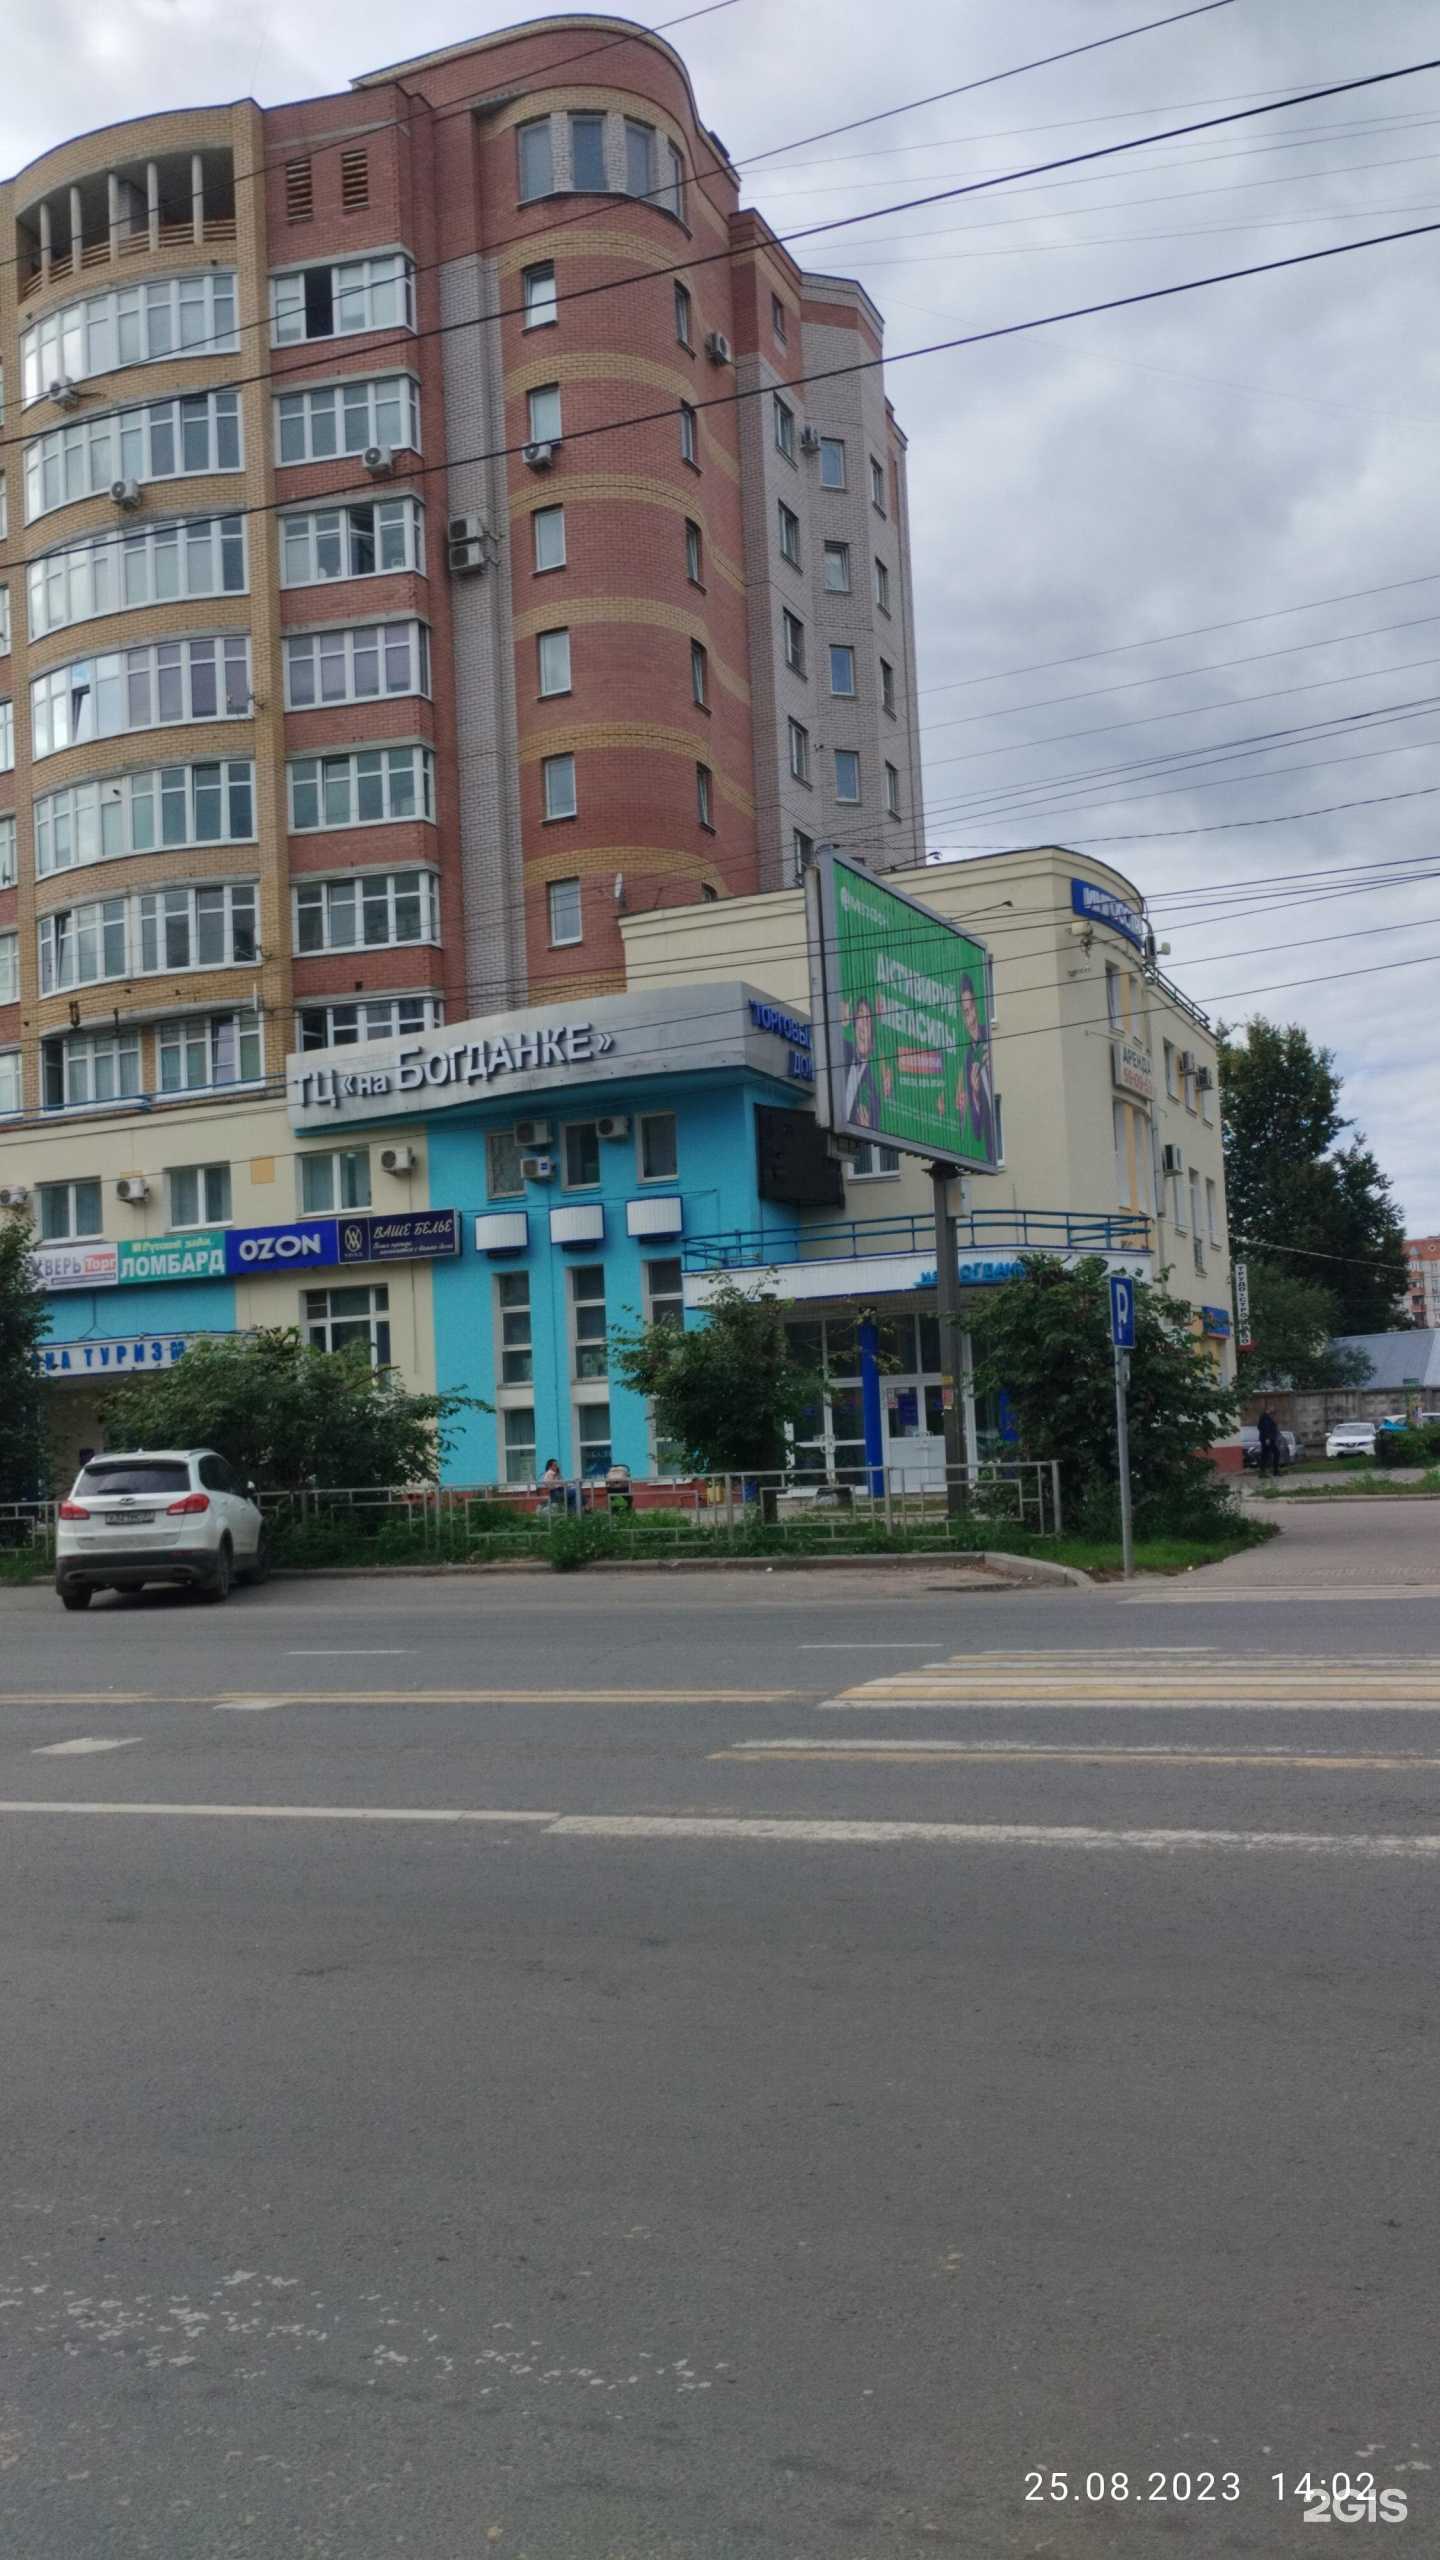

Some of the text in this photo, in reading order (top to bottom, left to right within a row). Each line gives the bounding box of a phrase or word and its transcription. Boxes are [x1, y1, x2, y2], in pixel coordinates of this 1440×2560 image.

[749, 1001, 811, 1050] ТОРГОВЫ
[296, 1070, 338, 1108] ТЦ
[373, 1219, 453, 1239] ВАШЕ БЕЛЬЕ
[238, 1233, 322, 1262] OZON
[119, 1248, 226, 1280] ЛОМБАРД
